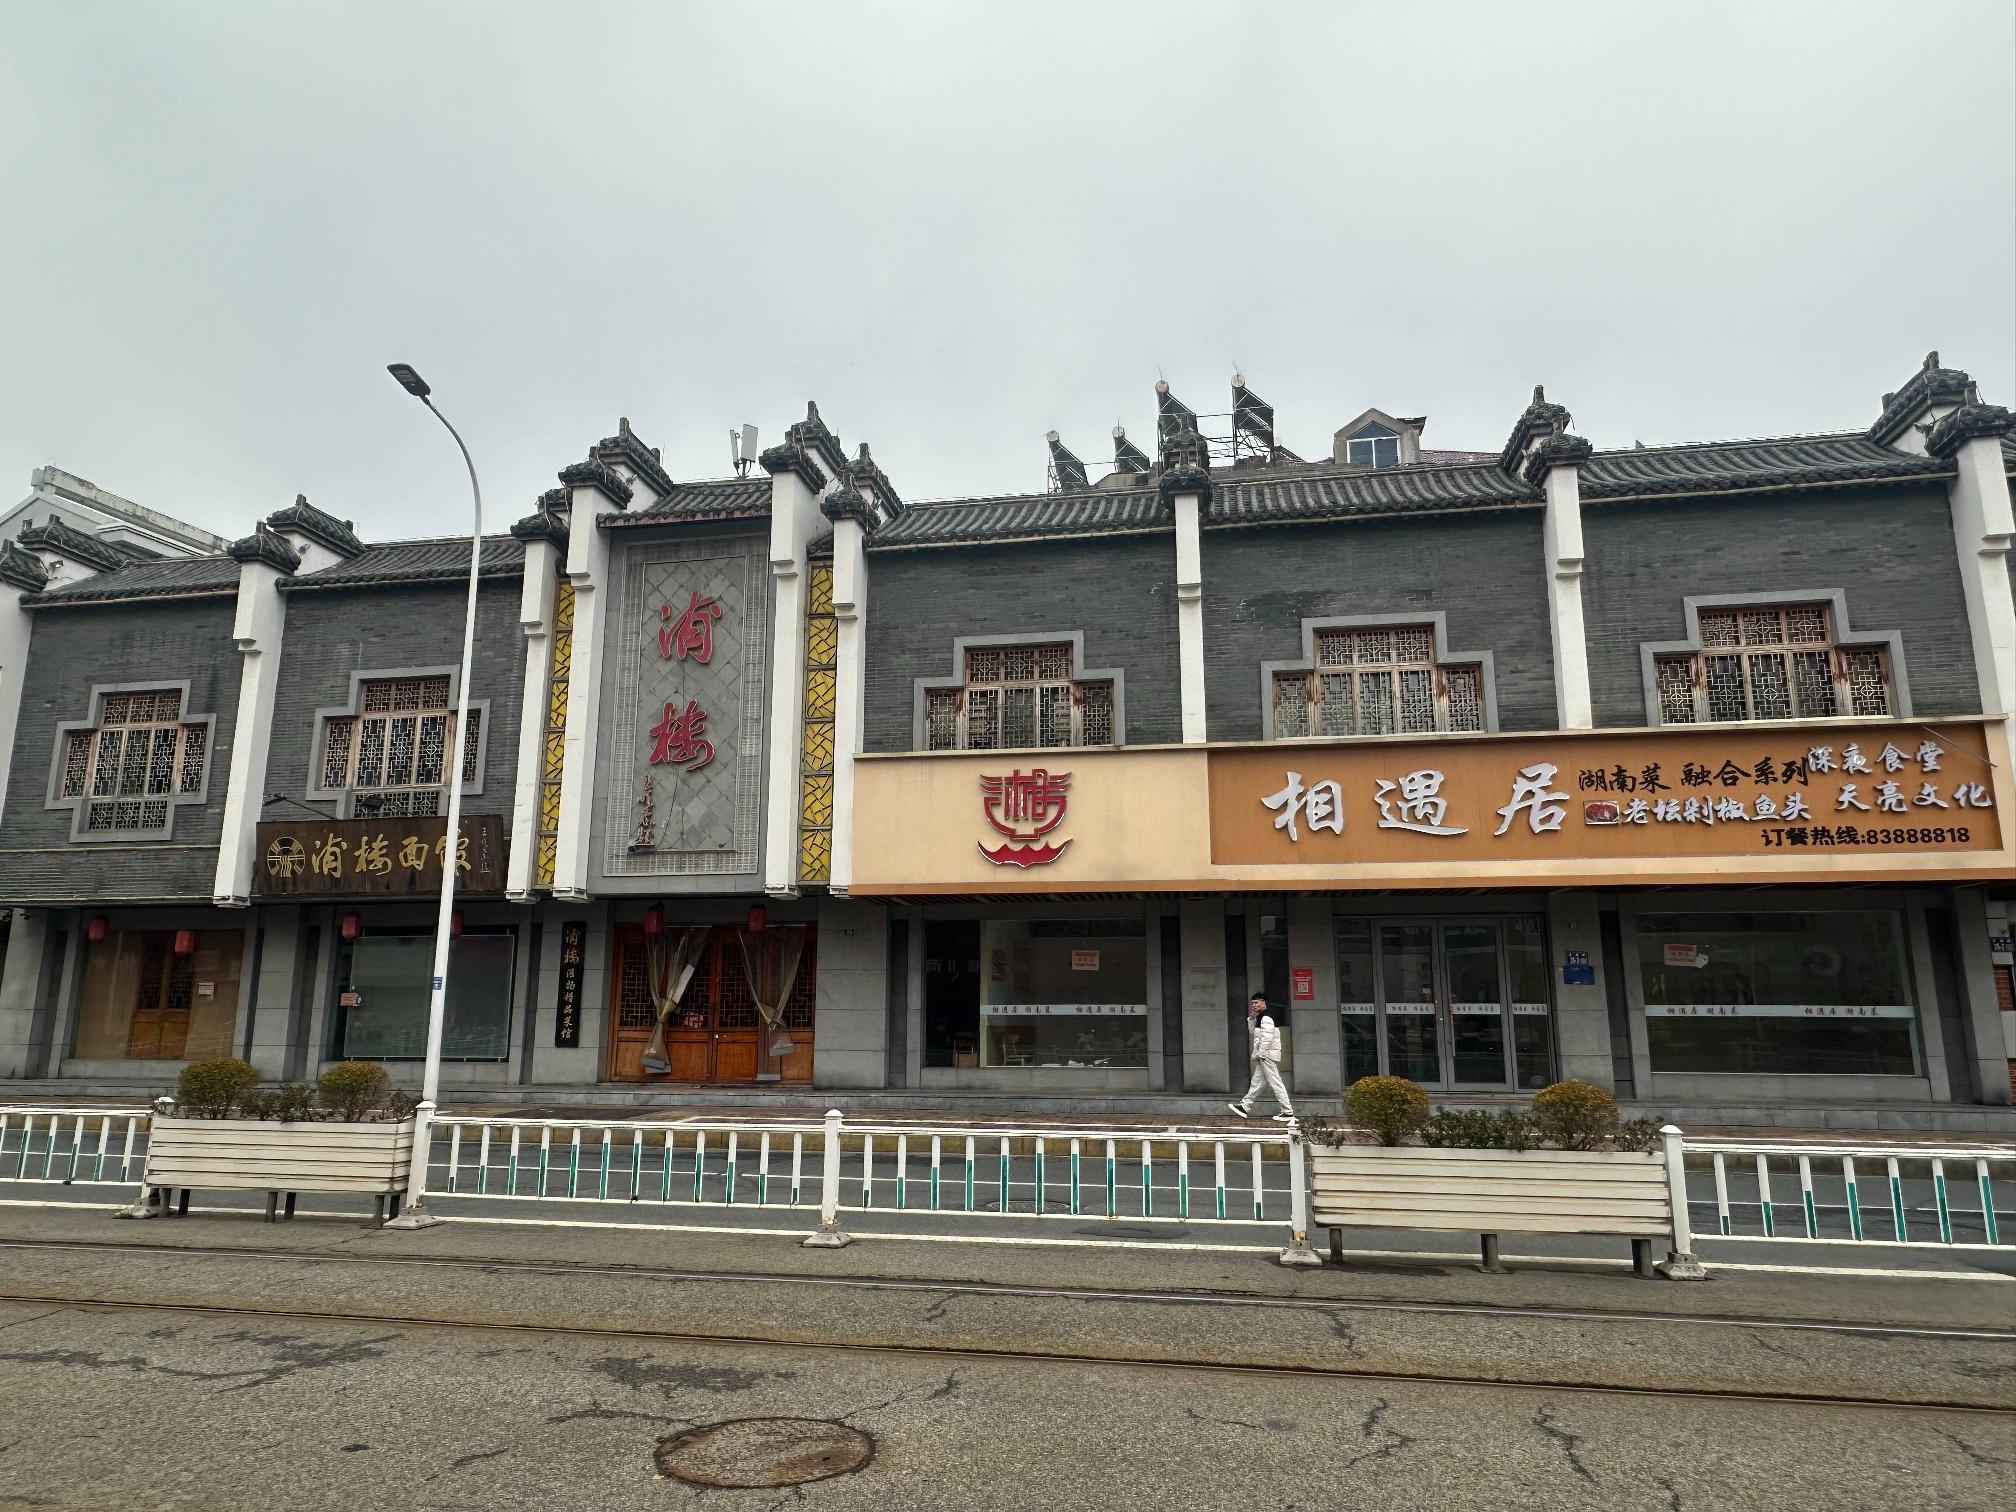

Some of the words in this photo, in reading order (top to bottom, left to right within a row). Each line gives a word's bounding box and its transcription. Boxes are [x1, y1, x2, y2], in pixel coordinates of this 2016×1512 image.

[1807, 741, 1945, 775] 深夜食堂
[1578, 763, 1672, 795] 湖南菜
[1680, 757, 1810, 788] 融合系列
[1261, 762, 1570, 842] 相遇居
[1622, 795, 1812, 826] 老坛剁椒鱼头
[1836, 781, 1993, 813] 天亮文化
